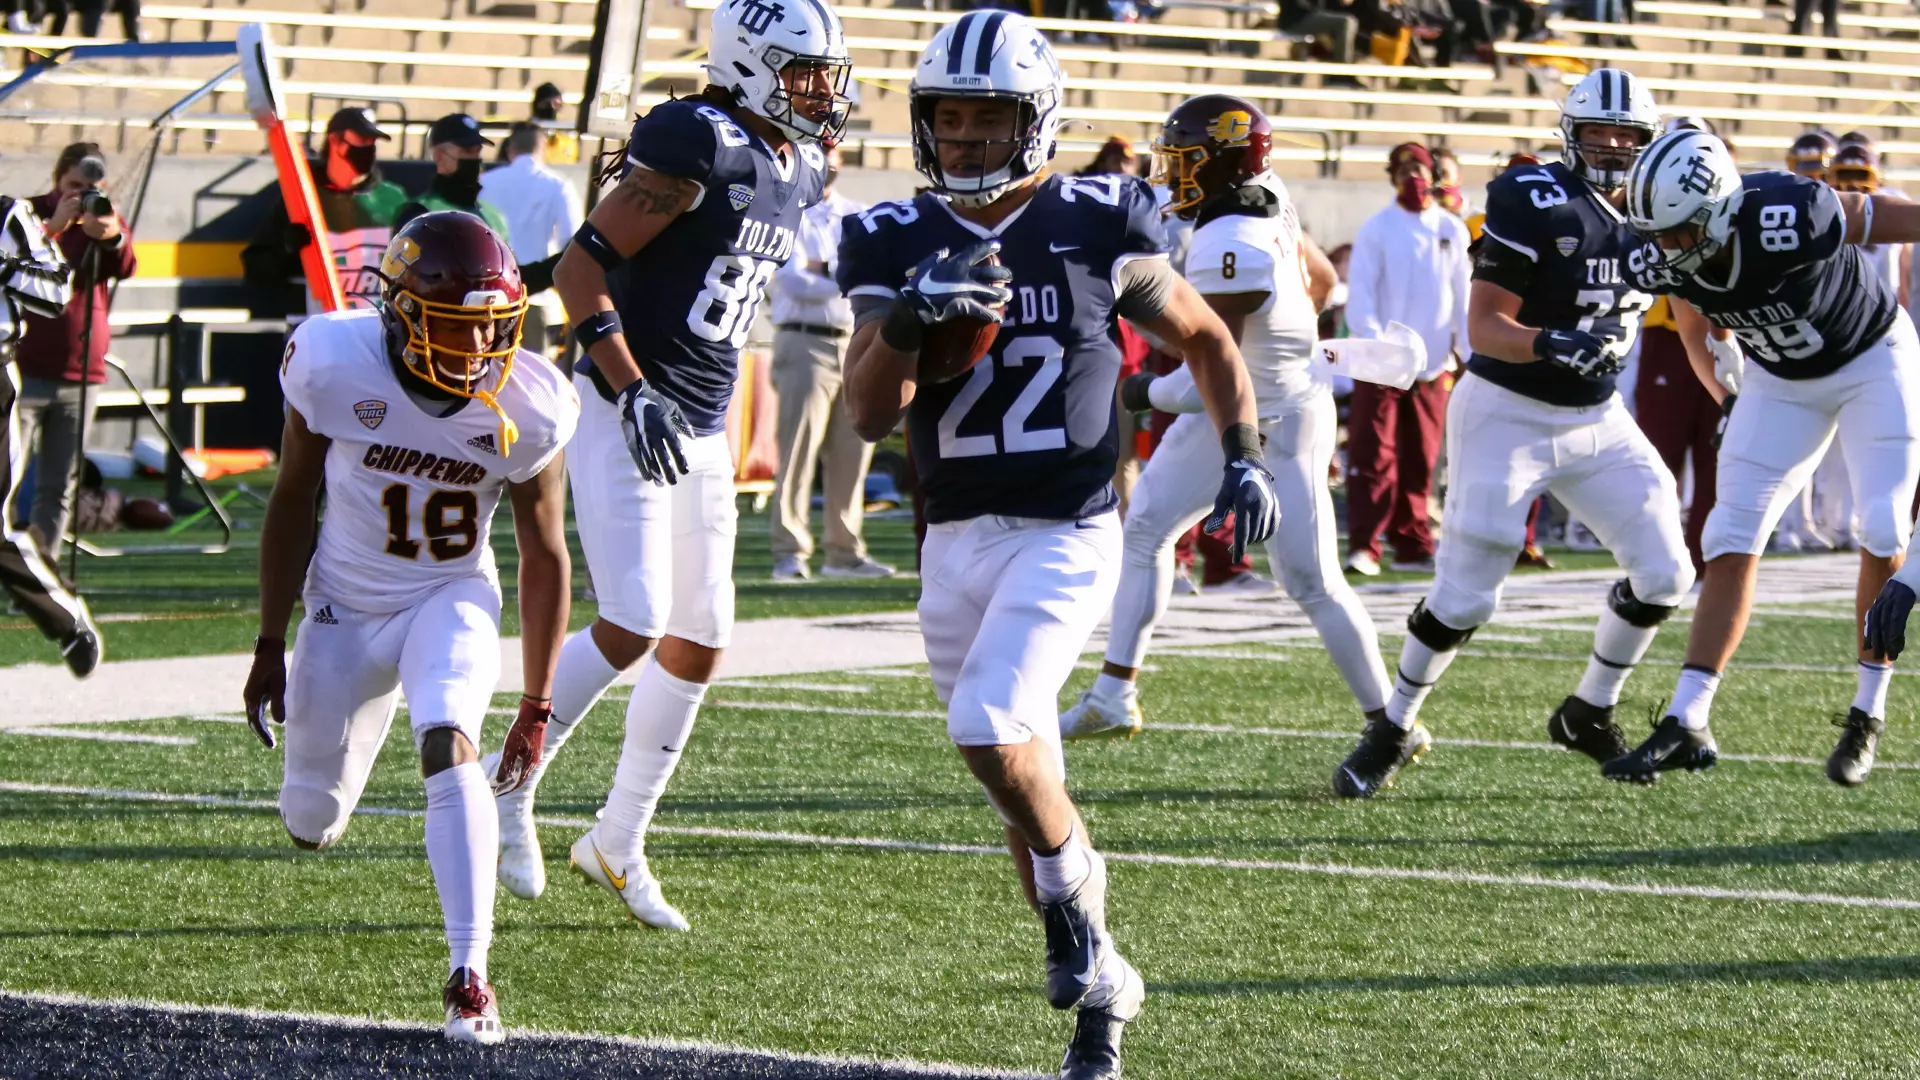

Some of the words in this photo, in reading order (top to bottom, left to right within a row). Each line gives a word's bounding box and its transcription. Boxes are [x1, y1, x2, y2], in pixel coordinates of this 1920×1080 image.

[968, 77, 981, 86] CITY
[728, 189, 753, 204] MAC
[1515, 168, 1568, 209] 73
[735, 217, 795, 261] TOLEDO
[1222, 251, 1236, 280] 8
[686, 255, 778, 349] 80
[1711, 302, 1794, 327] TOLEDO
[1575, 289, 1654, 357] 73
[937, 335, 1067, 459] 22
[357, 409, 386, 419] MAC
[466, 438, 498, 456] adidas
[313, 616, 339, 625] adidas
